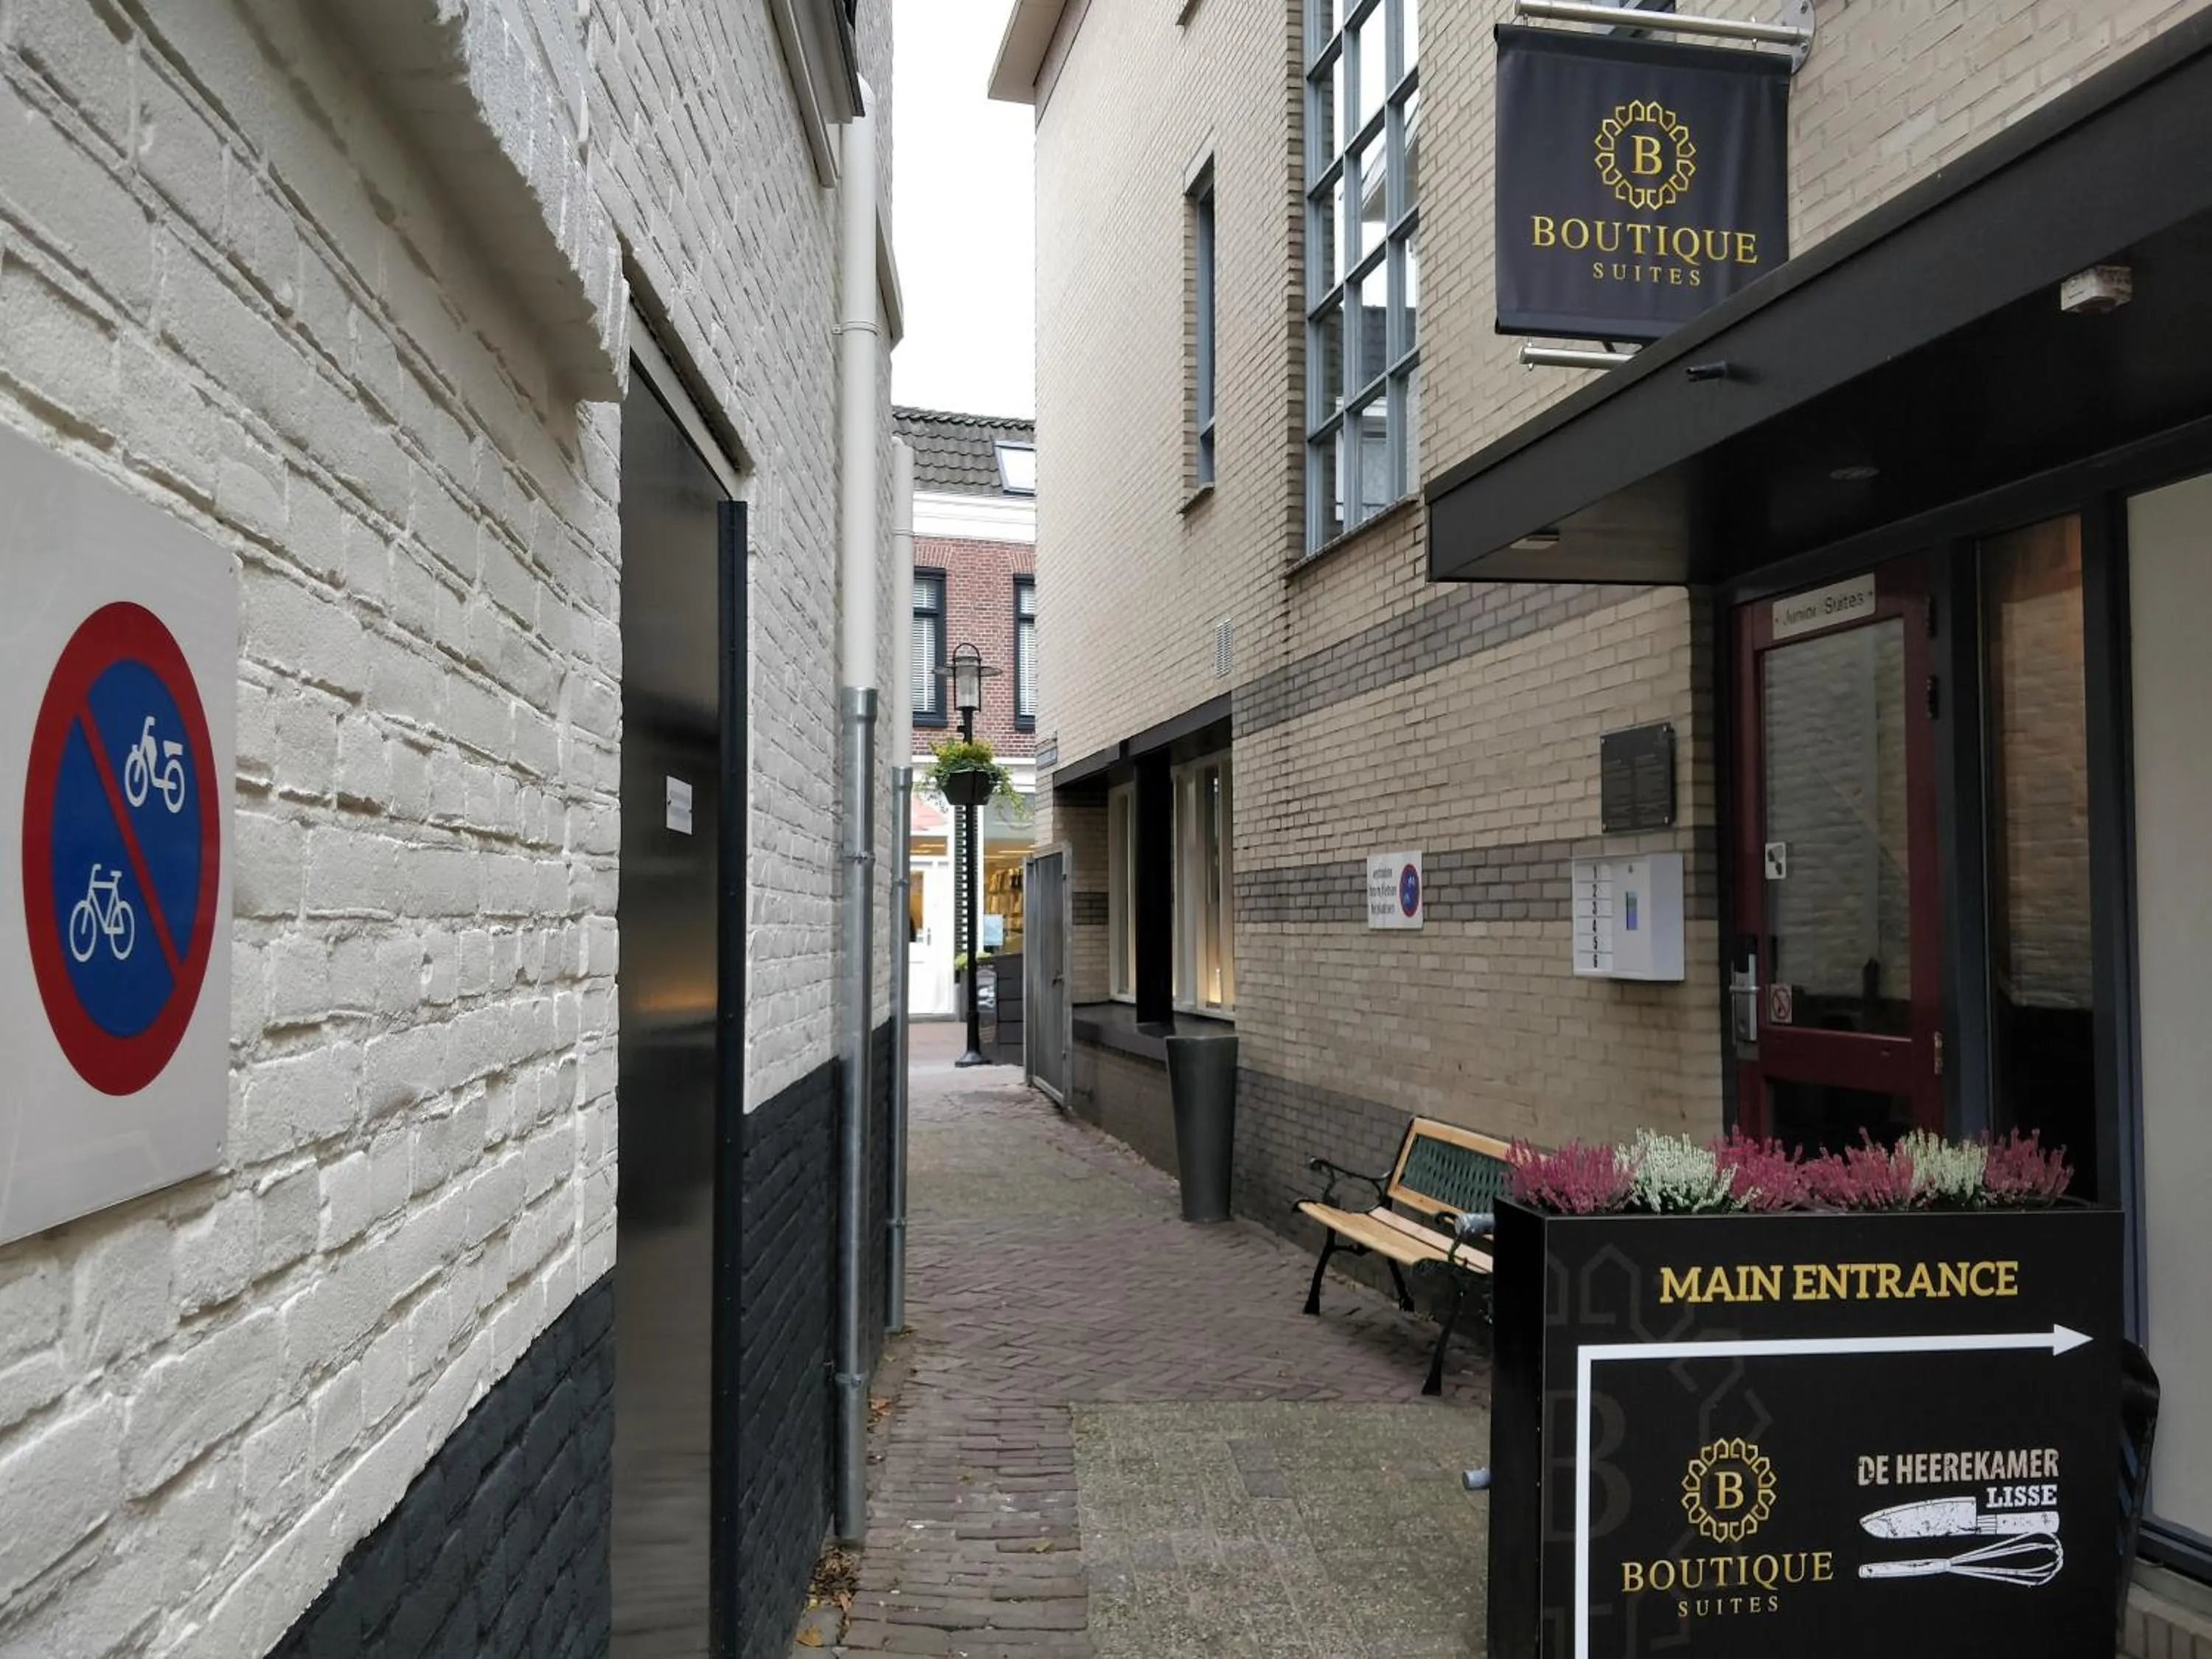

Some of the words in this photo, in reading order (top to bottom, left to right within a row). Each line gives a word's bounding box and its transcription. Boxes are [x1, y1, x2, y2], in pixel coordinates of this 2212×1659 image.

[1630, 135, 1663, 176] B
[1531, 215, 1758, 265] BOUTIQUE
[1593, 262, 1701, 286] SUITES
[1783, 606, 1817, 626] Junior
[1824, 592, 1865, 614] Suites
[1660, 1265, 1784, 1303] MAIN
[1792, 1261, 2018, 1300] ENTRANCE
[1857, 1455, 1889, 1486] DE
[1896, 1448, 2059, 1484] HEEREKAMER
[1714, 1471, 1745, 1509] B
[1986, 1484, 2058, 1508] LISSE
[1621, 1551, 1834, 1590] BOUTIQUE
[1678, 1595, 1779, 1617] SUITES
